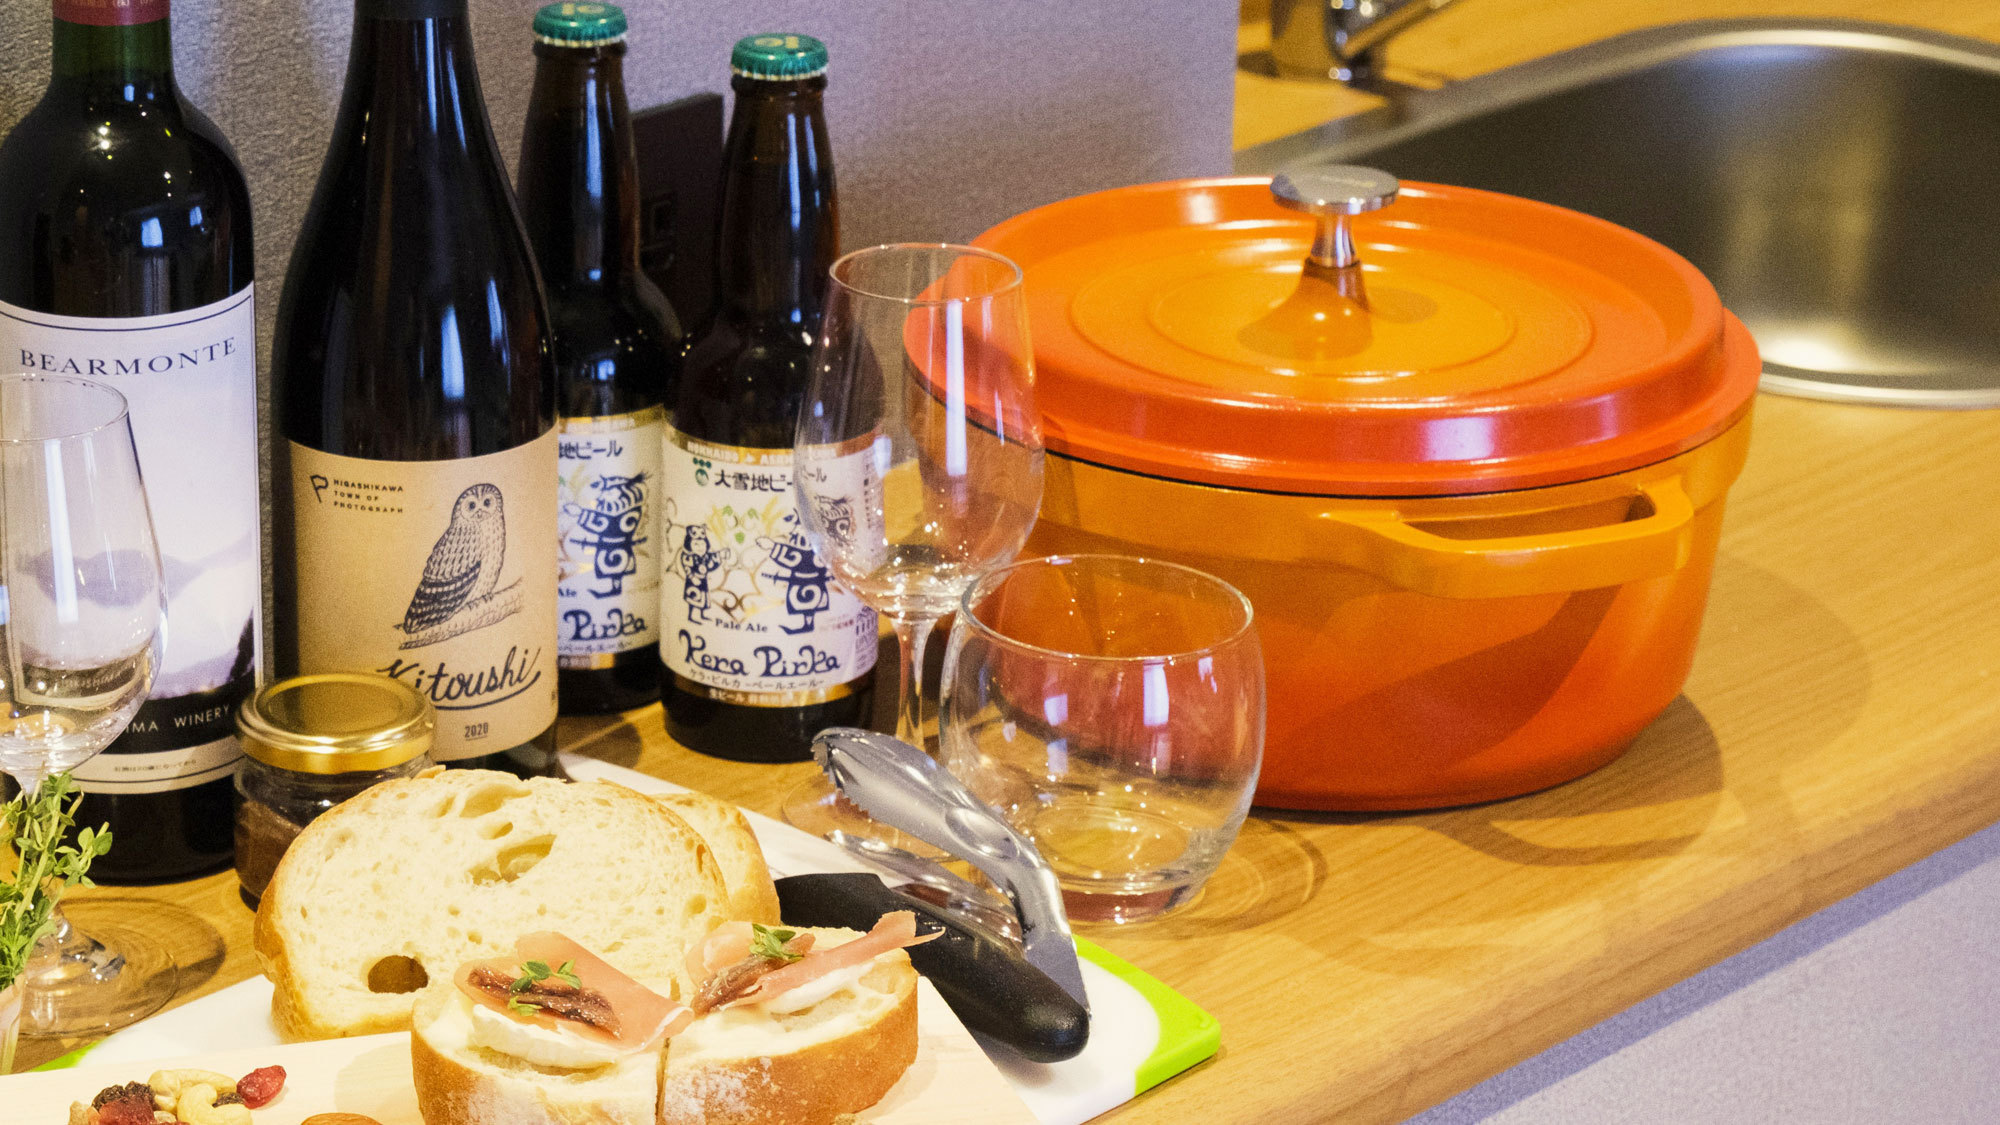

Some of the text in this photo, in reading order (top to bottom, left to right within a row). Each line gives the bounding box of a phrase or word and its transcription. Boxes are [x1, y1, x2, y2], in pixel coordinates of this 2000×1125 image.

[19, 337, 236, 375] BEARMONTE
[333, 478, 403, 492] HIGASHIKAWA
[334, 490, 360, 499] TOWN
[333, 500, 403, 513] PHOTOGRAPH
[563, 607, 648, 641] Pirka
[715, 618, 769, 633] Pale Ale
[678, 629, 840, 677] Kera Pirka
[124, 704, 230, 734] IMA WINERY
[464, 722, 489, 738] 2020
